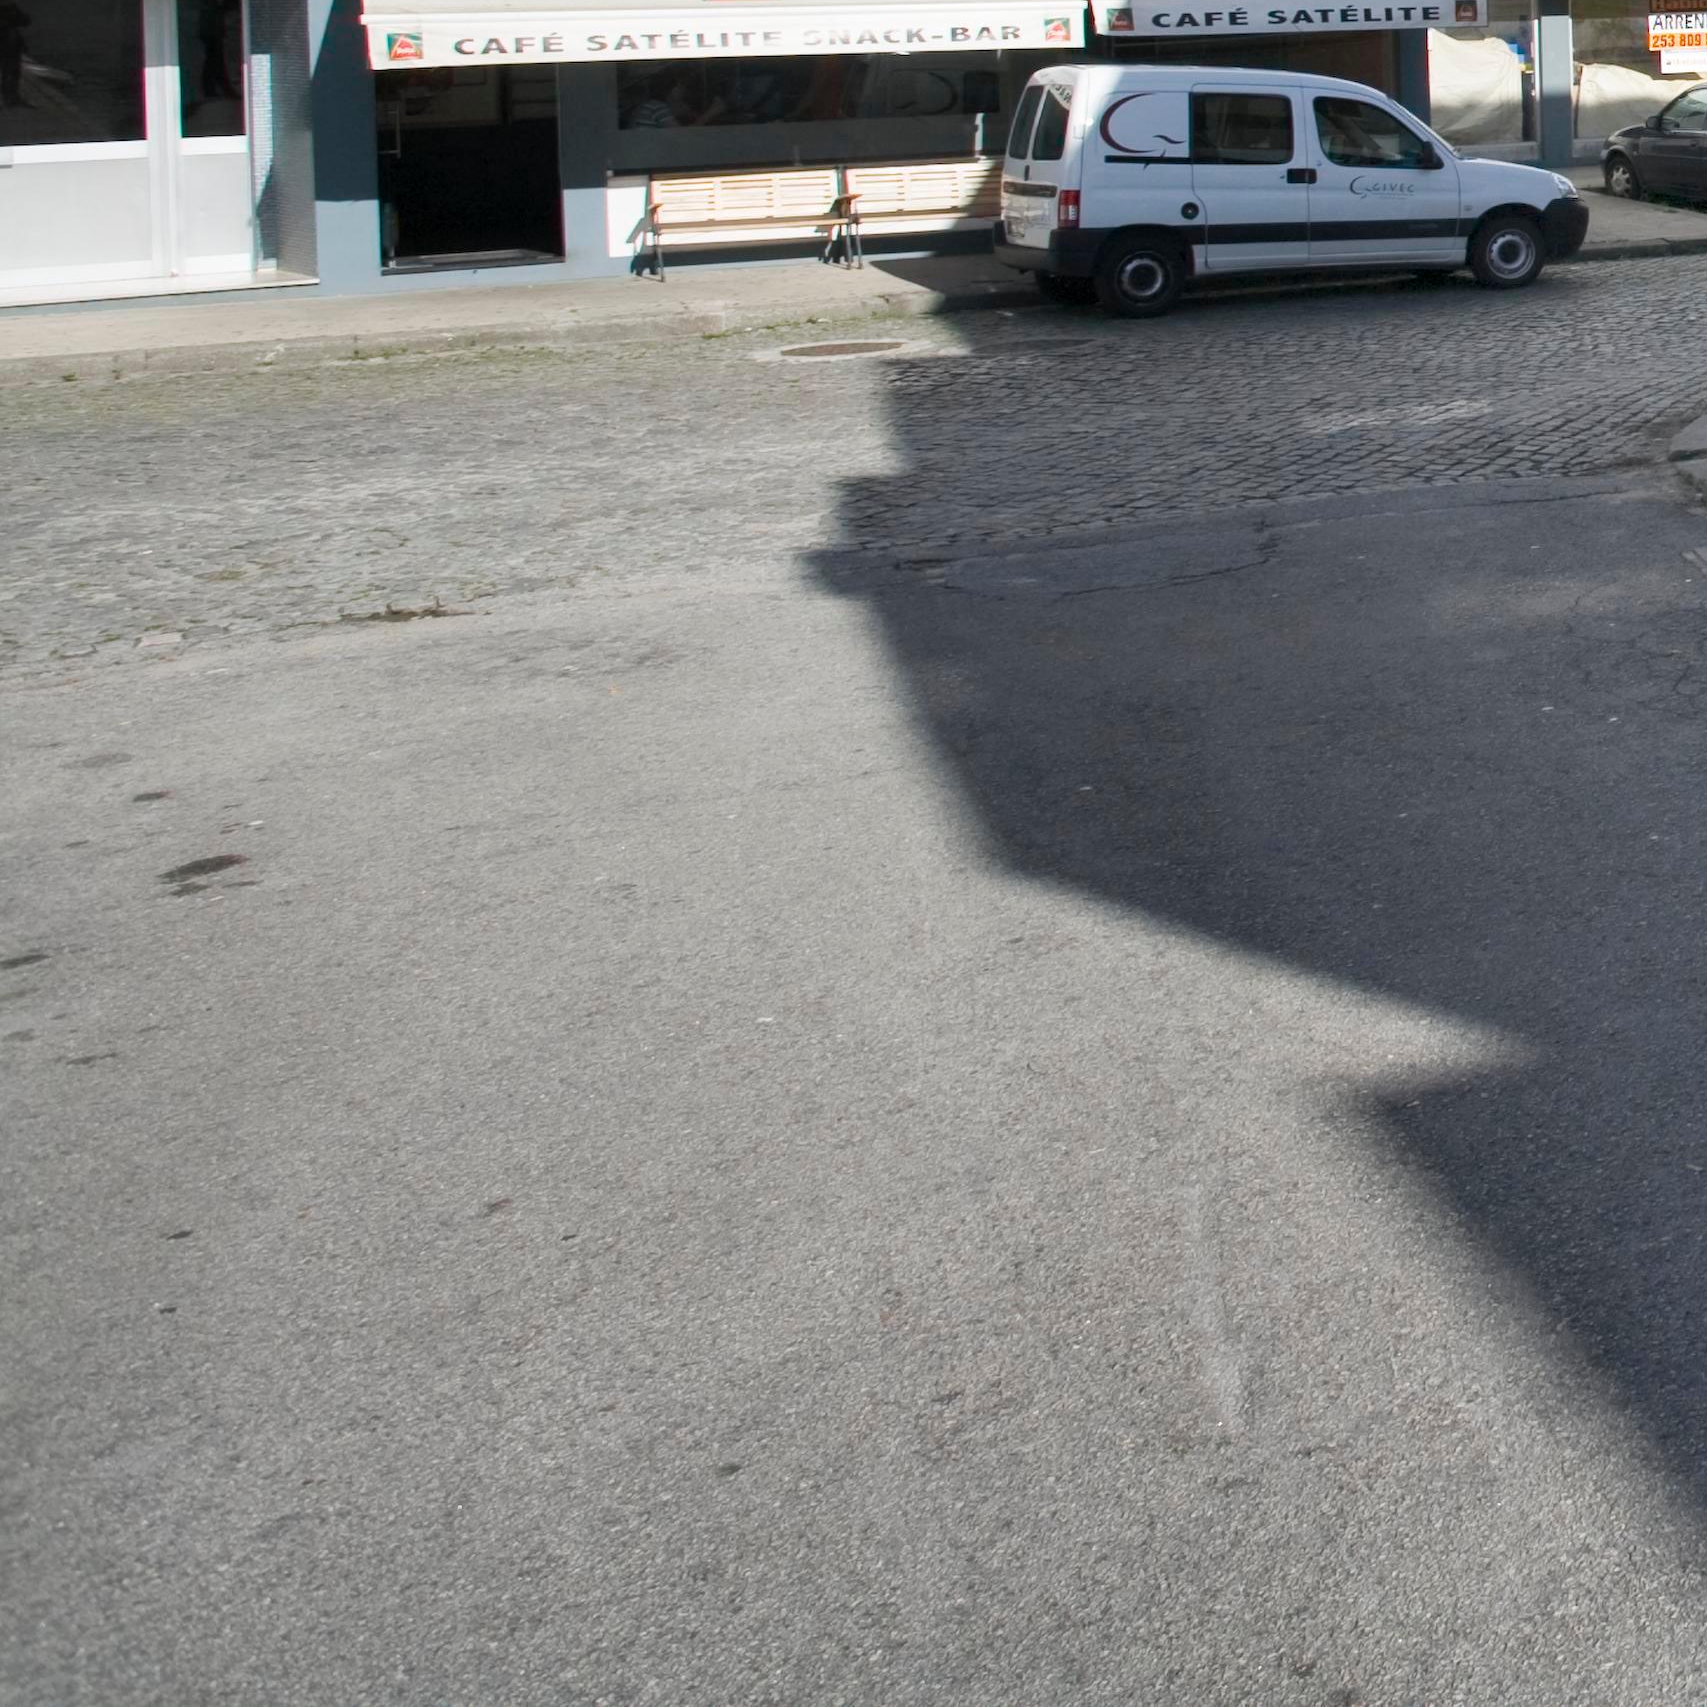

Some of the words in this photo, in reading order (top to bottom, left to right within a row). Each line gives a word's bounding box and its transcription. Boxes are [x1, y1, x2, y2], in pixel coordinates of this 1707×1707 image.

[1152, 7, 1249, 28] CAFÉ
[1267, 5, 1440, 25] SATÉLITE
[454, 32, 564, 55] CAFÉ
[586, 29, 783, 51] SATÉLITE
[803, 26, 1022, 46] SNACK-BAR
[1652, 35, 1675, 48] 253
[1680, 34, 1701, 46] 809
